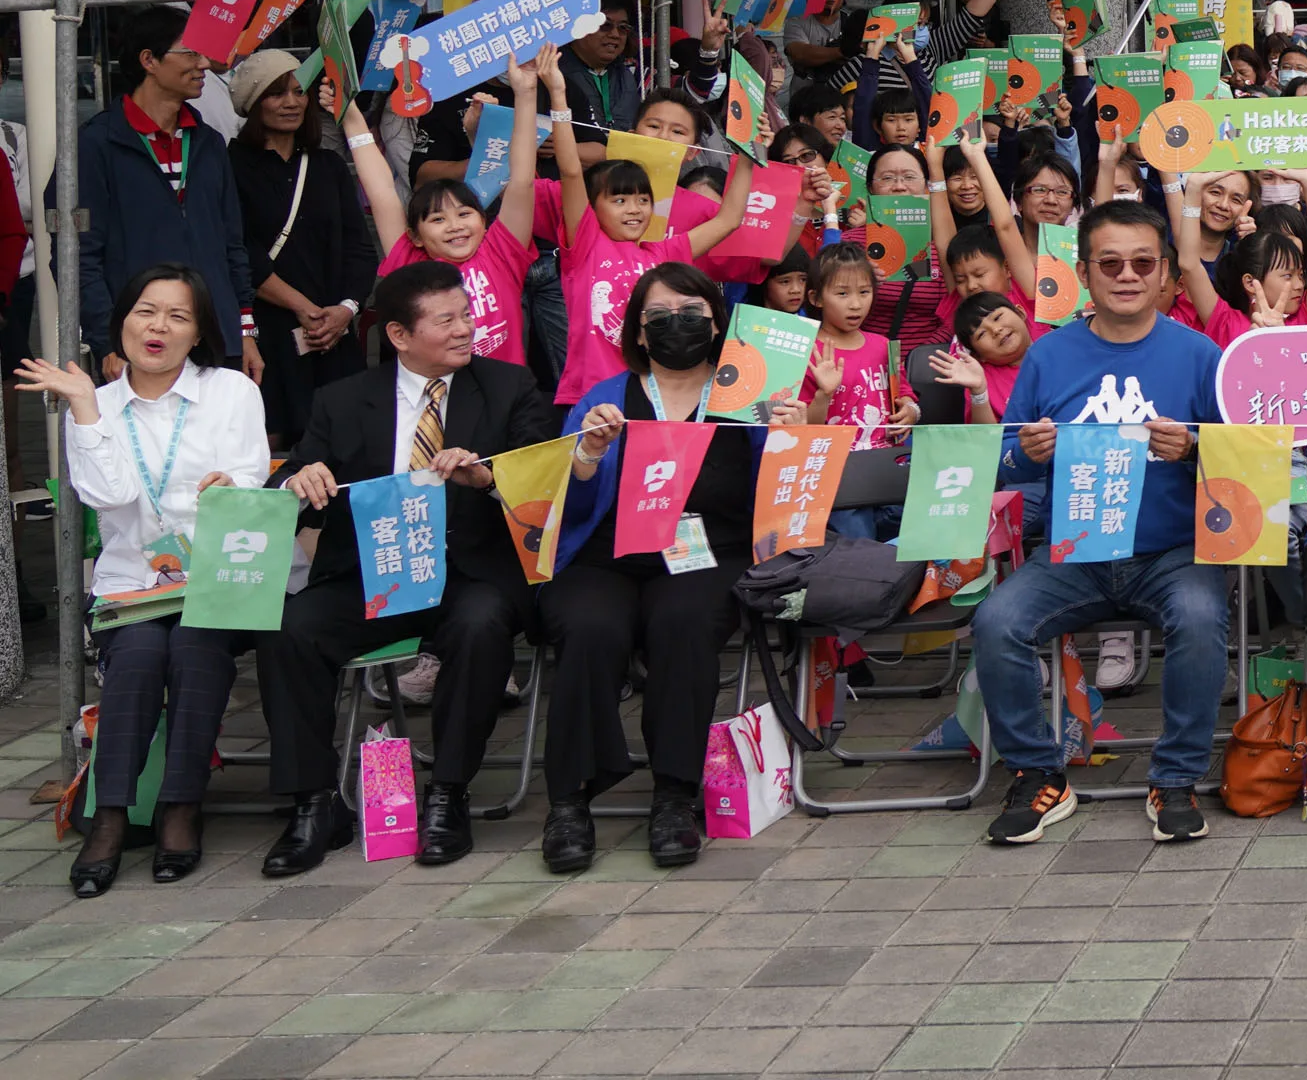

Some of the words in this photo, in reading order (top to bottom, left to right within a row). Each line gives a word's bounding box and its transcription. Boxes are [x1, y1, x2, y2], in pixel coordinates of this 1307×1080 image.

[447, 6, 571, 77] 富岡國民小學
[773, 465, 798, 507] 唱出
[786, 436, 832, 538] 新時代个聲
[1068, 462, 1099, 522] 客語
[1100, 447, 1133, 535] 新校歌
[370, 515, 403, 576] 客語
[401, 493, 436, 585] 新校歌
